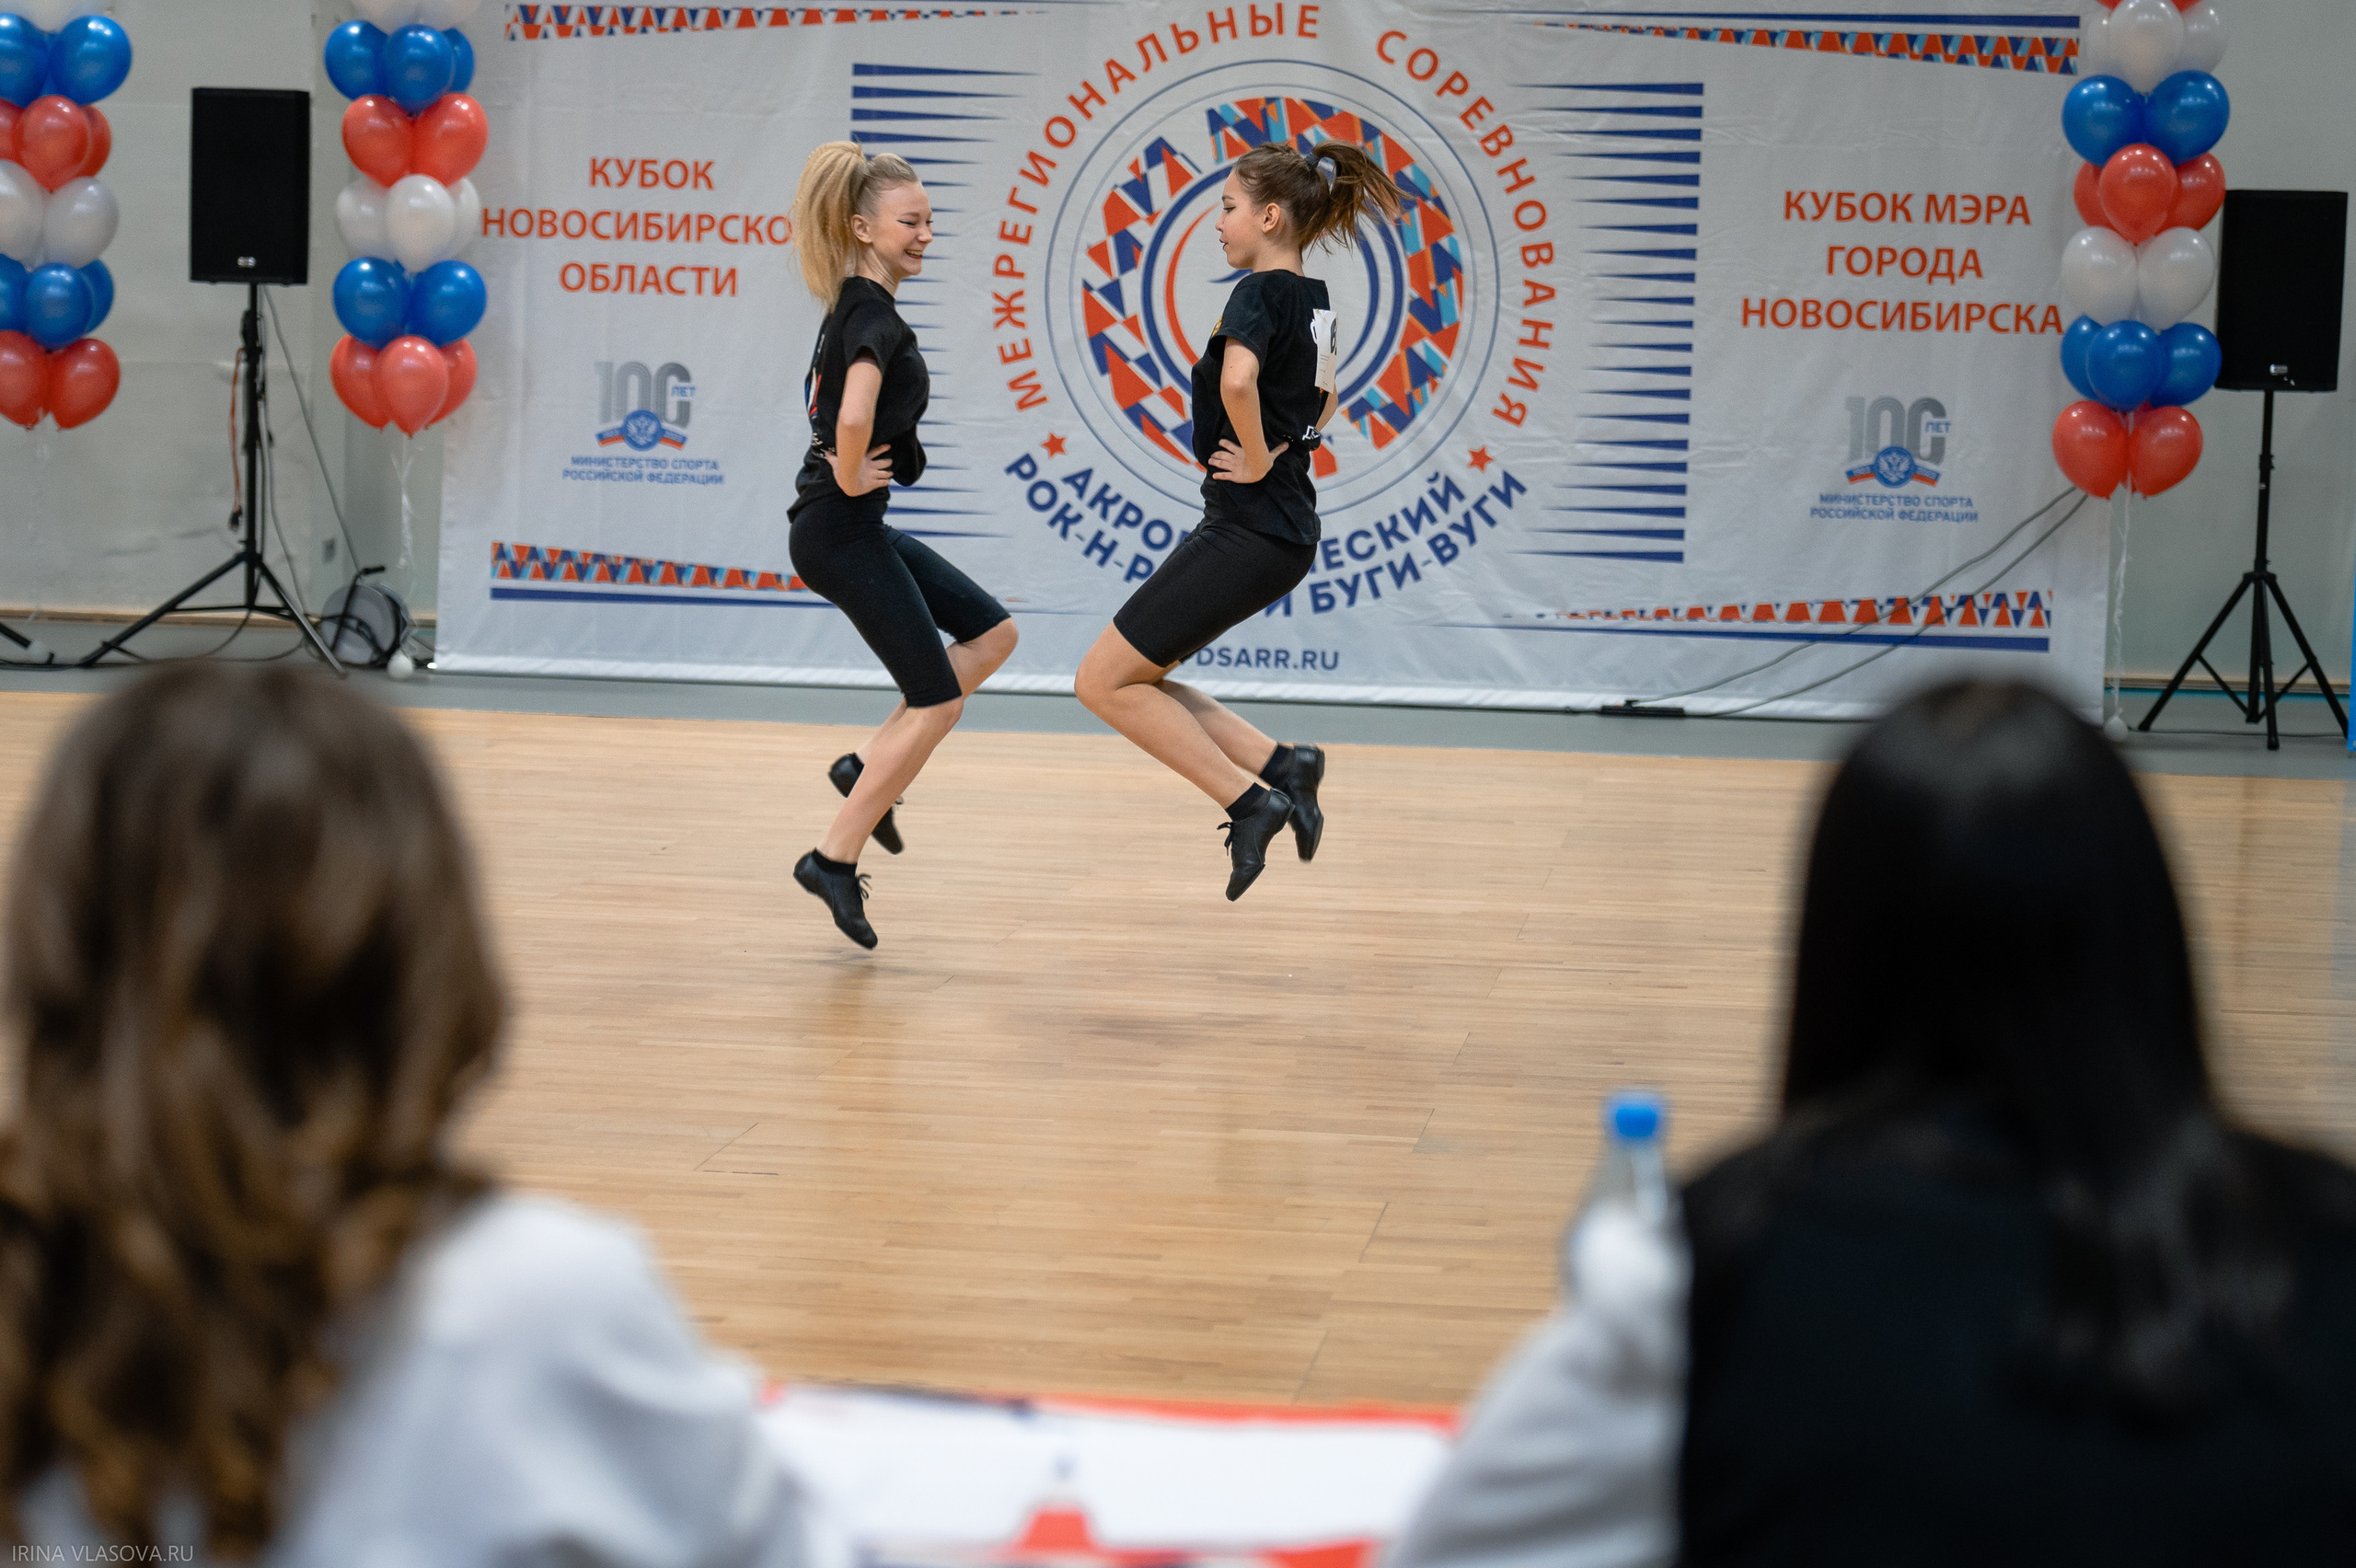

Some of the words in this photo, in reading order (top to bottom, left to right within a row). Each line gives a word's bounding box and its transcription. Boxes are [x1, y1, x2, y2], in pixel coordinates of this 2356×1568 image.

[588, 156, 715, 190] КУБОК
[991, 1, 1321, 412] МЕЖРЕГИОНАЛЬНЫЕ
[1375, 29, 1558, 428] СОРЕВНОВАНИЯ
[1784, 190, 1913, 224] КУБОК
[1923, 193, 2031, 225] МЭРА
[481, 206, 793, 246] НОВОСИБИРСКО
[559, 261, 738, 297] ОБЛАСТИ
[1827, 245, 1983, 285] ГОРОДА
[1741, 296, 2063, 334] НОВОСИБИРСКА
[672, 386, 697, 398] ЛЕТ
[1925, 421, 1951, 433] ЛЕТ
[561, 468, 643, 482] РОССИЙСКОЙ
[646, 472, 724, 485] ФЕДЕРАЦИИ
[571, 456, 668, 469] МИНИСТЕРСТВО
[671, 458, 720, 470] СПОРТА
[1810, 507, 1895, 521] РОССИЙСКОЙ
[1898, 510, 1979, 524] ФЕДЕРАЦИИ
[1819, 494, 1921, 507] МИНИСТЕРСТВО
[1924, 496, 1973, 507] СПОРТА
[1004, 453, 1154, 584] РОК-Н-Р
[1308, 470, 1528, 616] БУГИ-ВУГИ
[1061, 467, 1467, 574] АКРОЕСКИЙ
[1196, 647, 1340, 672] DSARR.RU
